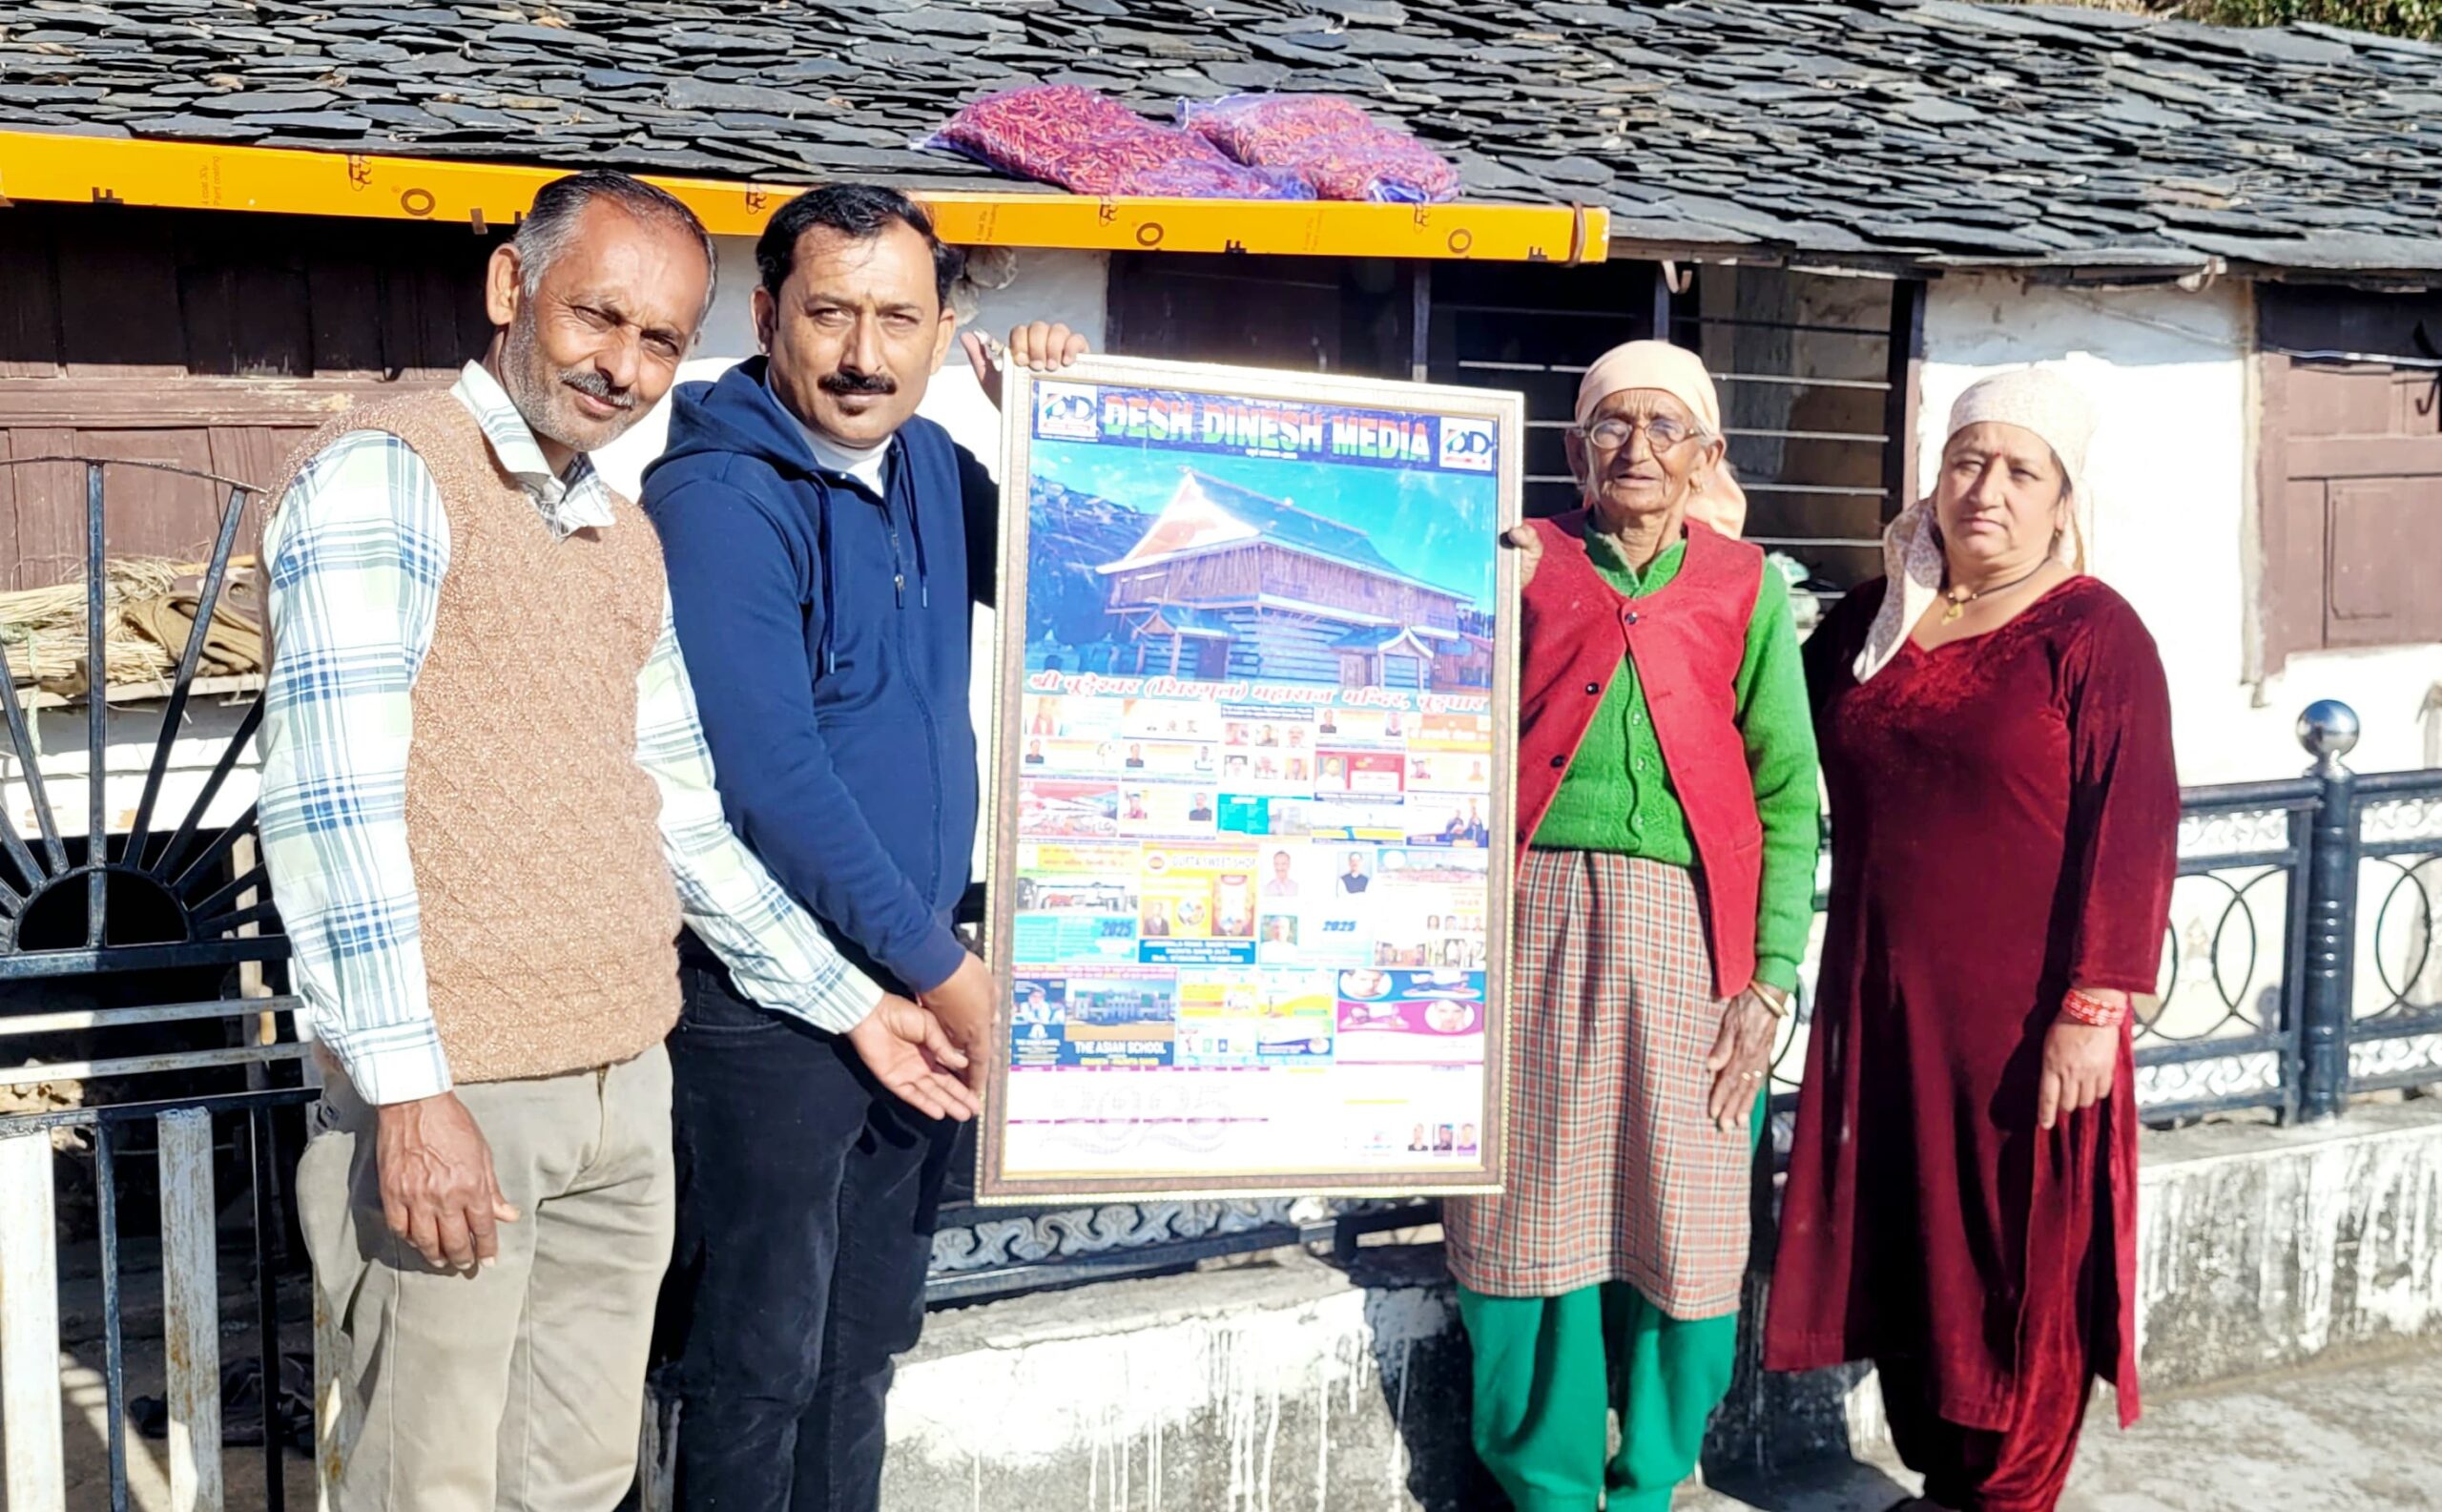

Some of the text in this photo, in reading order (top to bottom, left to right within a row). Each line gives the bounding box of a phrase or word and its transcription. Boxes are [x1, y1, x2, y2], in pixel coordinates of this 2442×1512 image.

[1105, 395, 1431, 463] DESH DINESH MEDIA
[1321, 919, 1357, 933] 2025
[1074, 1041, 1095, 1054] THE
[1096, 1041, 1127, 1054] ASIAN
[1128, 1042, 1168, 1055] SCHOOL
